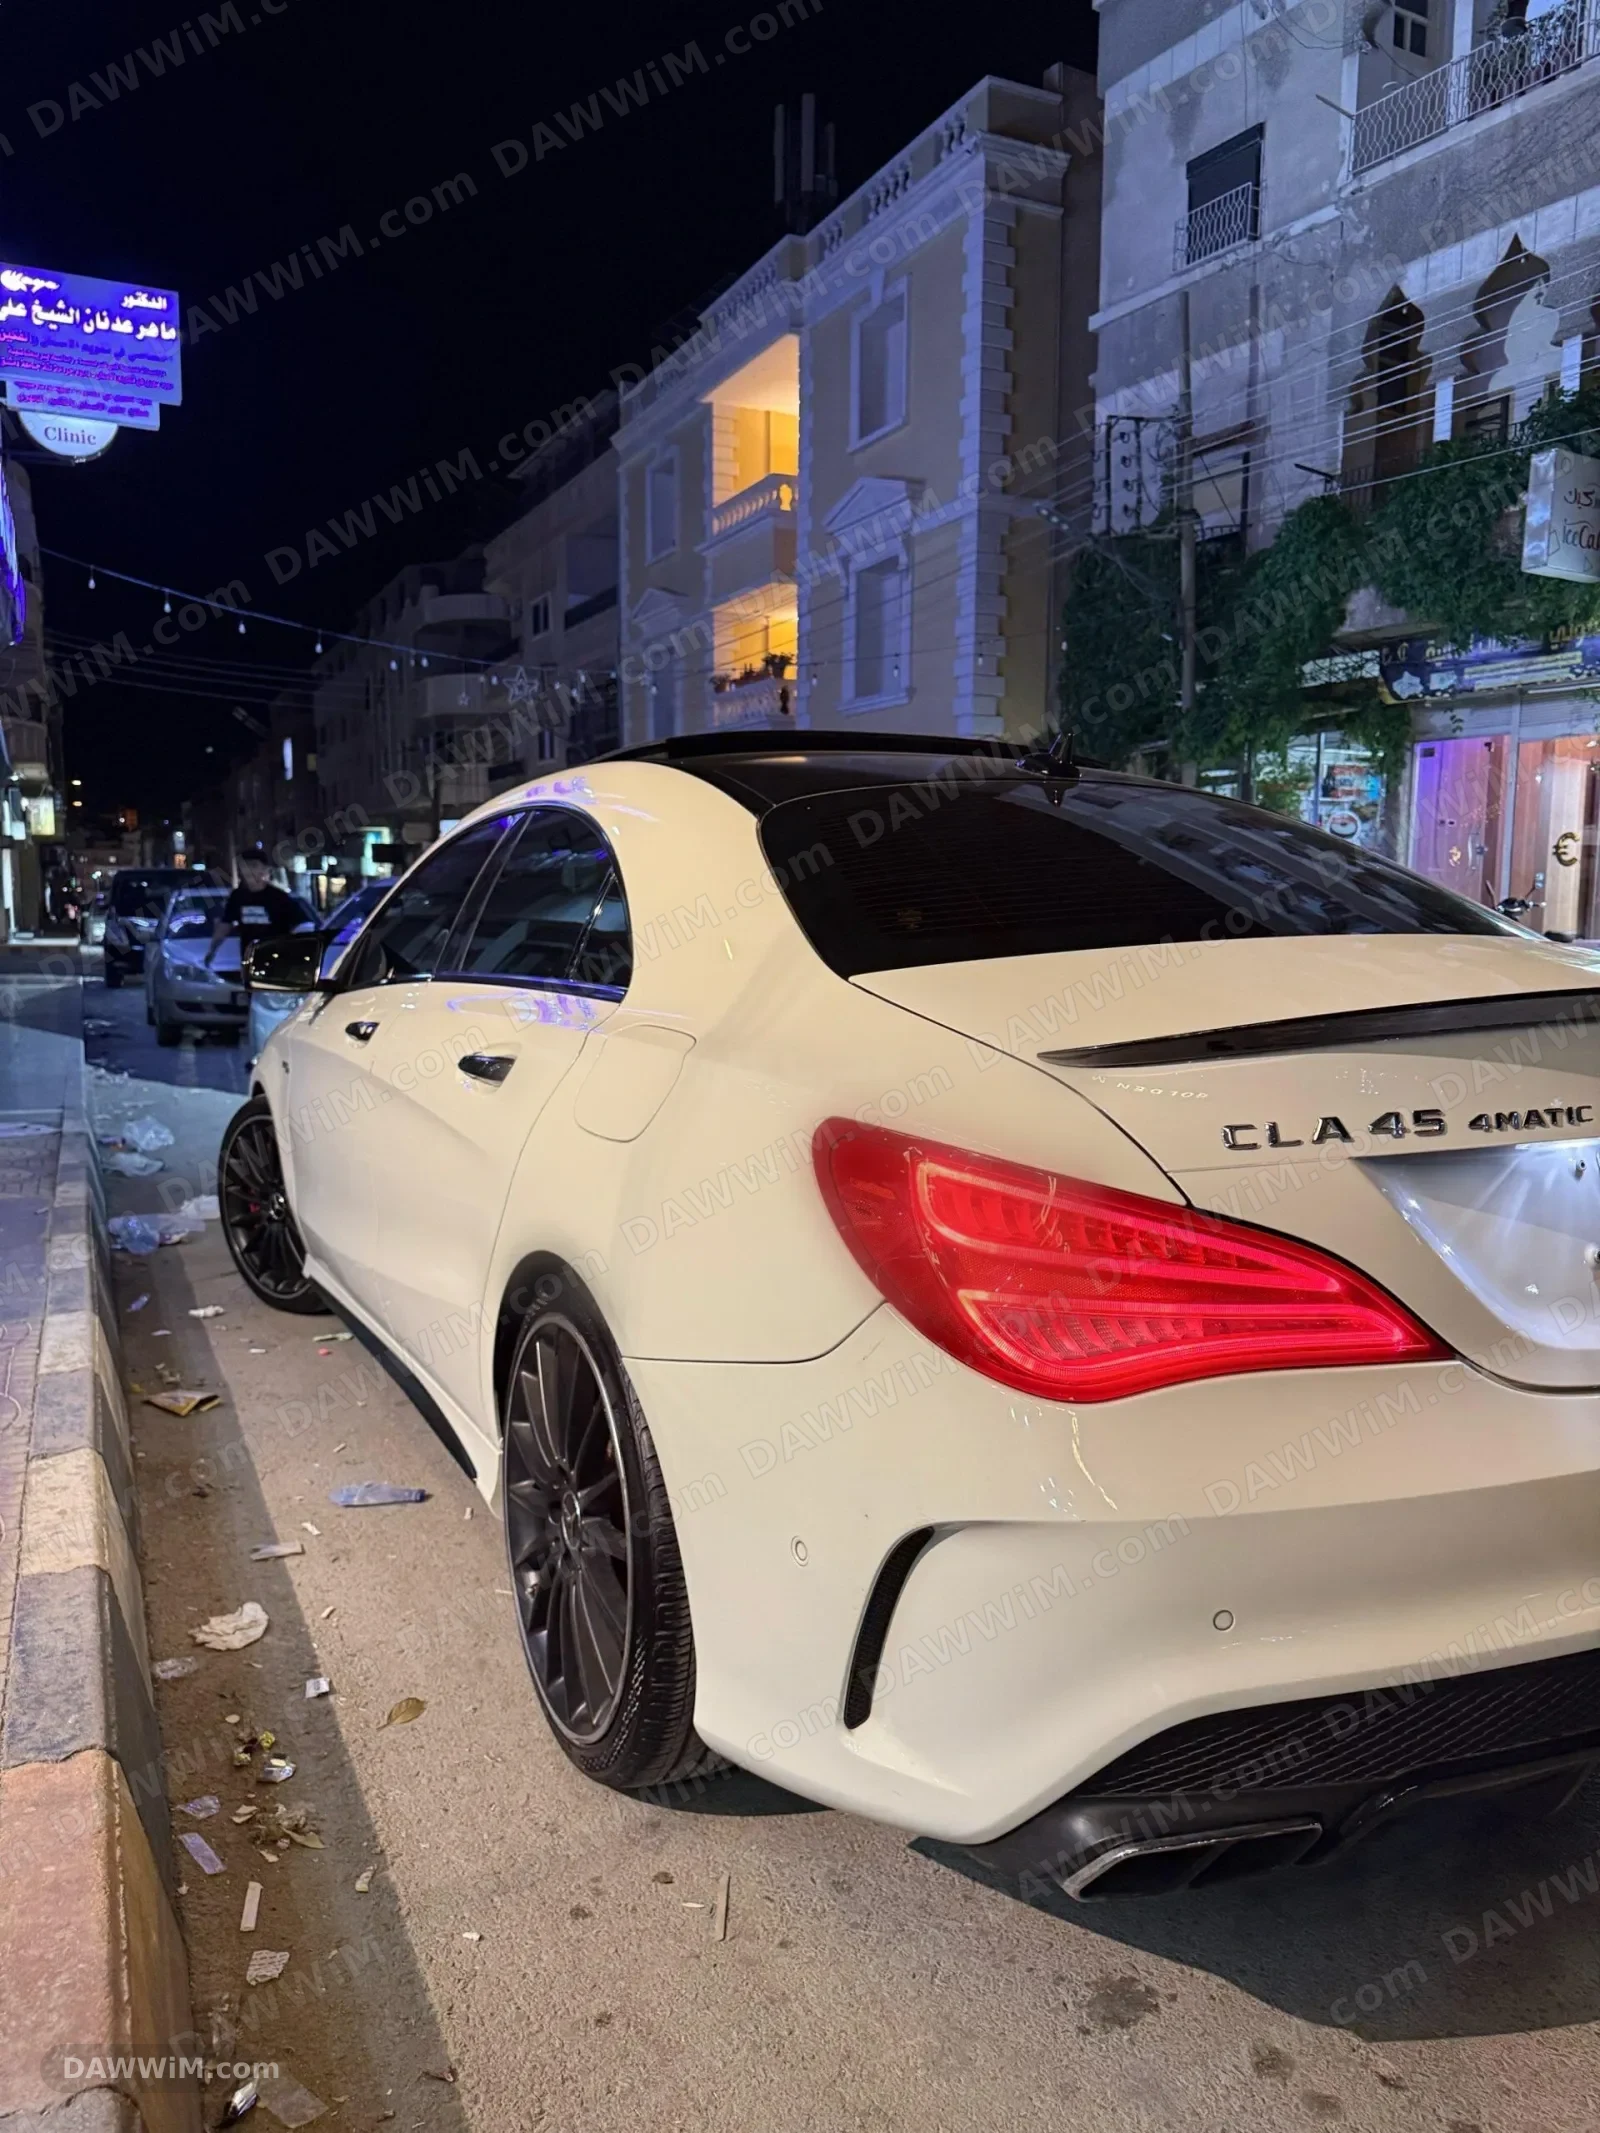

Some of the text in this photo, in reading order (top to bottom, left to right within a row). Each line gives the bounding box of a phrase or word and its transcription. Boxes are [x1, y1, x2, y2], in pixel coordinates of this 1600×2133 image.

[31, 299, 81, 331] الشيخ
[83, 308, 134, 335] عدنان
[136, 321, 177, 341] ماهر
[44, 426, 97, 445] Clinic
[1221, 1104, 1594, 1151] CLA 45 4MATIC
